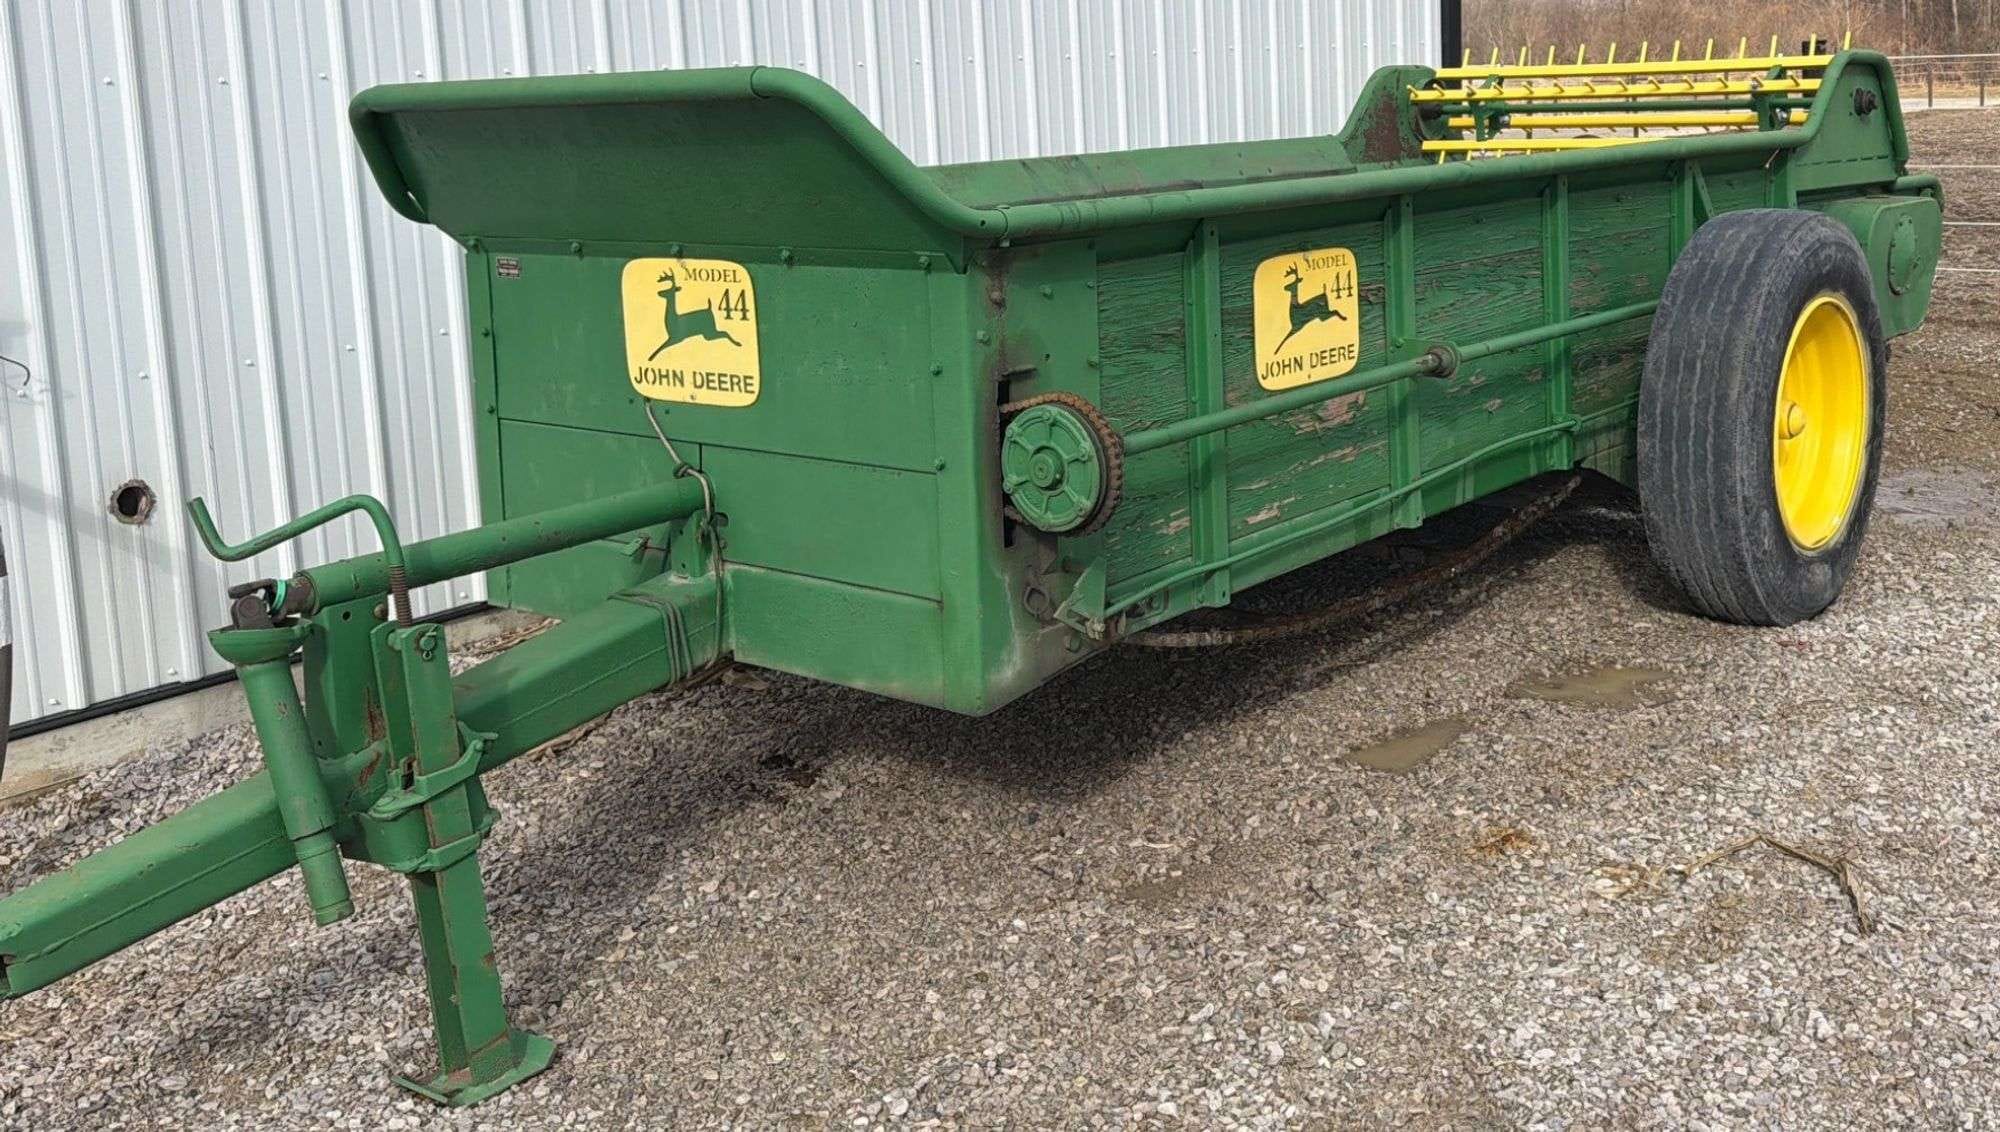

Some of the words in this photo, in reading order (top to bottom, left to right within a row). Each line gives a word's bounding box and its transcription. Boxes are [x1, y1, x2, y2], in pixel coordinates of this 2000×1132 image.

[683, 267, 742, 284] MODEL
[1305, 254, 1348, 272] MODEL
[1331, 269, 1354, 299] 44
[718, 288, 750, 322] 44
[1261, 355, 1303, 380] JOHN
[1309, 343, 1355, 369] DEERE
[634, 366, 685, 388] JOHN
[693, 371, 756, 394] DEERE
